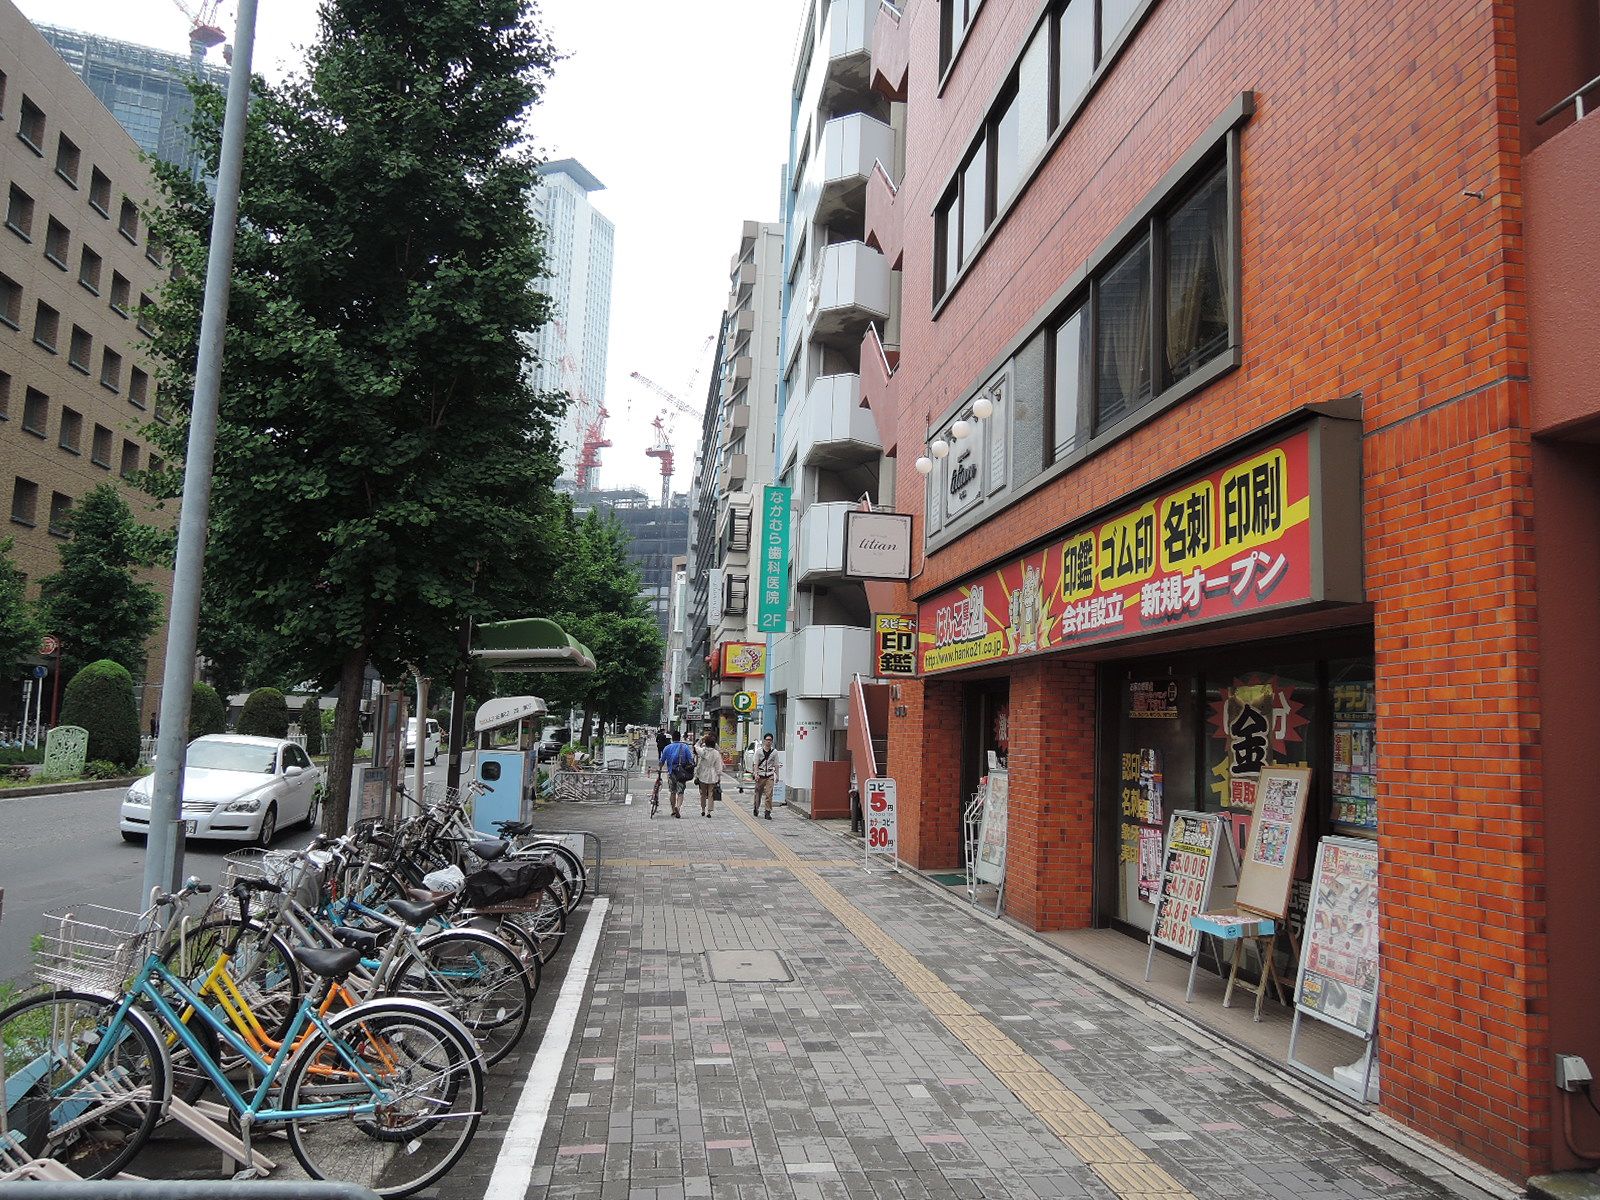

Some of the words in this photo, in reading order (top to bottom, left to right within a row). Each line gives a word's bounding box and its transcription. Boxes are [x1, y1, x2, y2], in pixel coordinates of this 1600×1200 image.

[1063, 537, 1093, 597] 印鑑
[1101, 514, 1153, 580] ゴム印
[1164, 487, 1211, 563] 名刺
[1225, 456, 1281, 546] 印刷
[765, 490, 785, 605] なかむら歯科医院
[1062, 592, 1125, 635] 会社設立
[1141, 550, 1287, 617] 新規オープン
[763, 613, 782, 627] 2F
[881, 618, 916, 629] スピード
[880, 632, 912, 673] 印鑑
[739, 695, 750, 709] P
[1231, 703, 1268, 774] 金
[869, 783, 893, 792] コピー
[870, 792, 893, 812] 5円
[870, 818, 894, 827] カラーコピー
[869, 827, 893, 847] 30円
